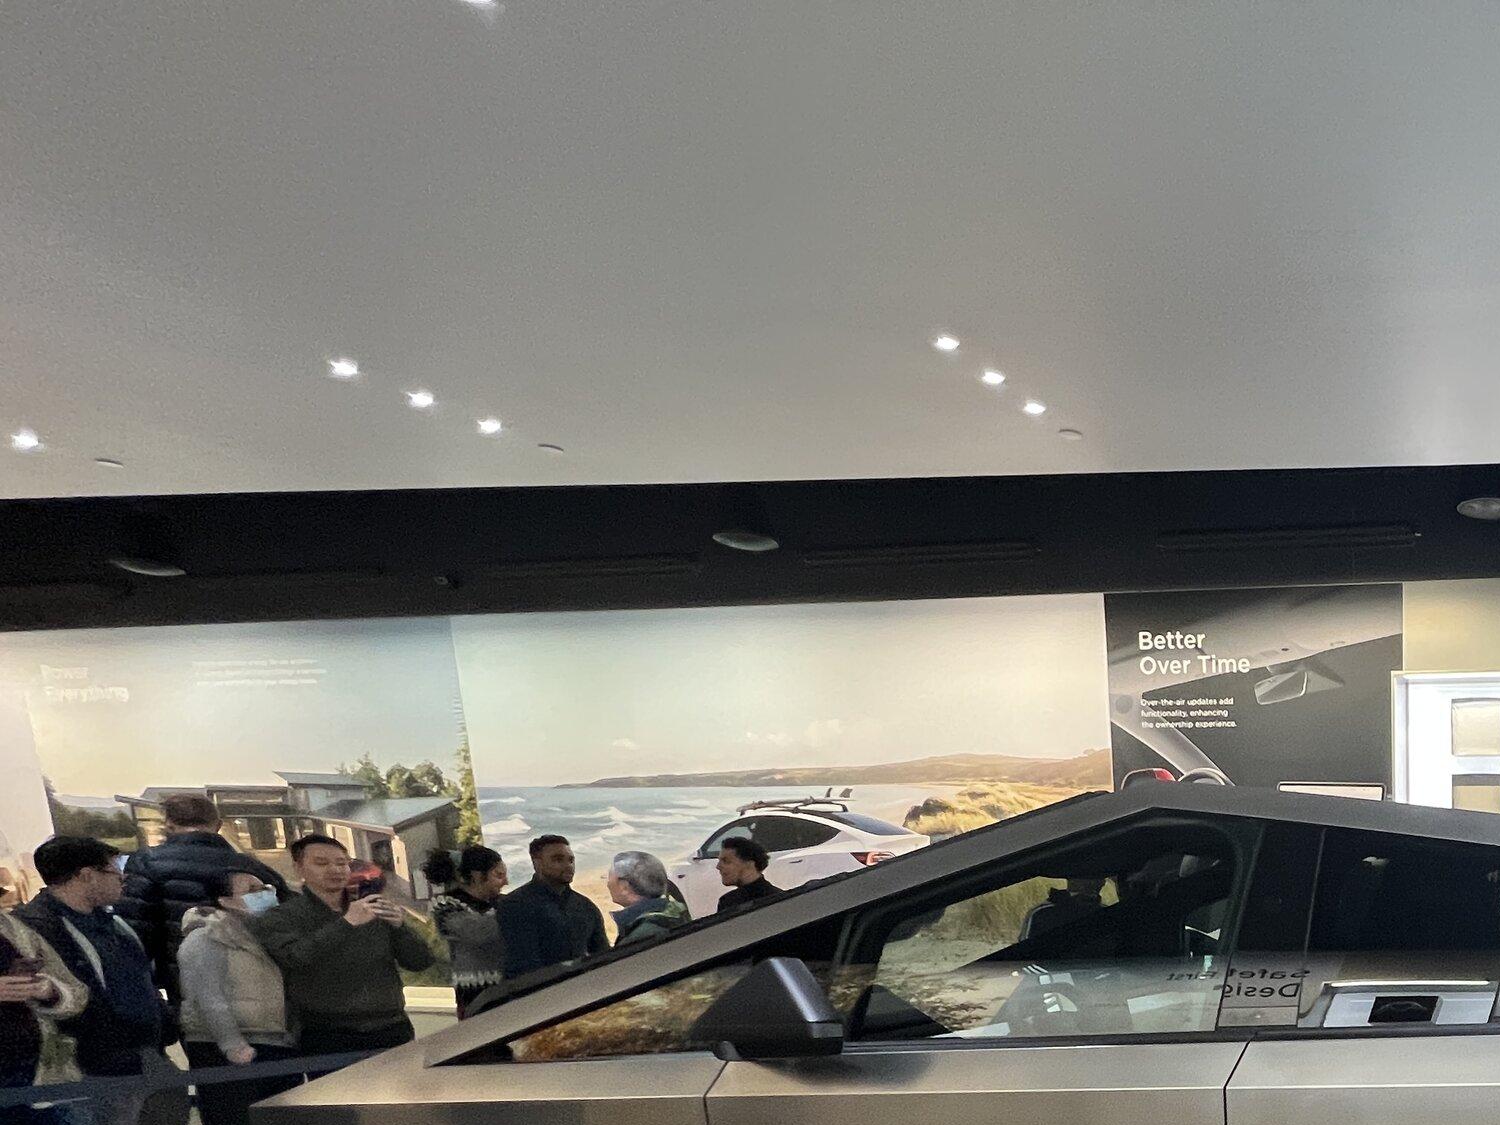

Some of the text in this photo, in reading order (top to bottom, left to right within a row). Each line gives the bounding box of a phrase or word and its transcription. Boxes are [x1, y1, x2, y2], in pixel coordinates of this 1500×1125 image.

[1138, 630, 1206, 650] Better
[1139, 654, 1251, 675] Over Time
[1140, 697, 1235, 706] Over-the-air updates add
[1140, 709, 1229, 718] functionality, enhancing
[1141, 721, 1238, 729] the ownership experience.
